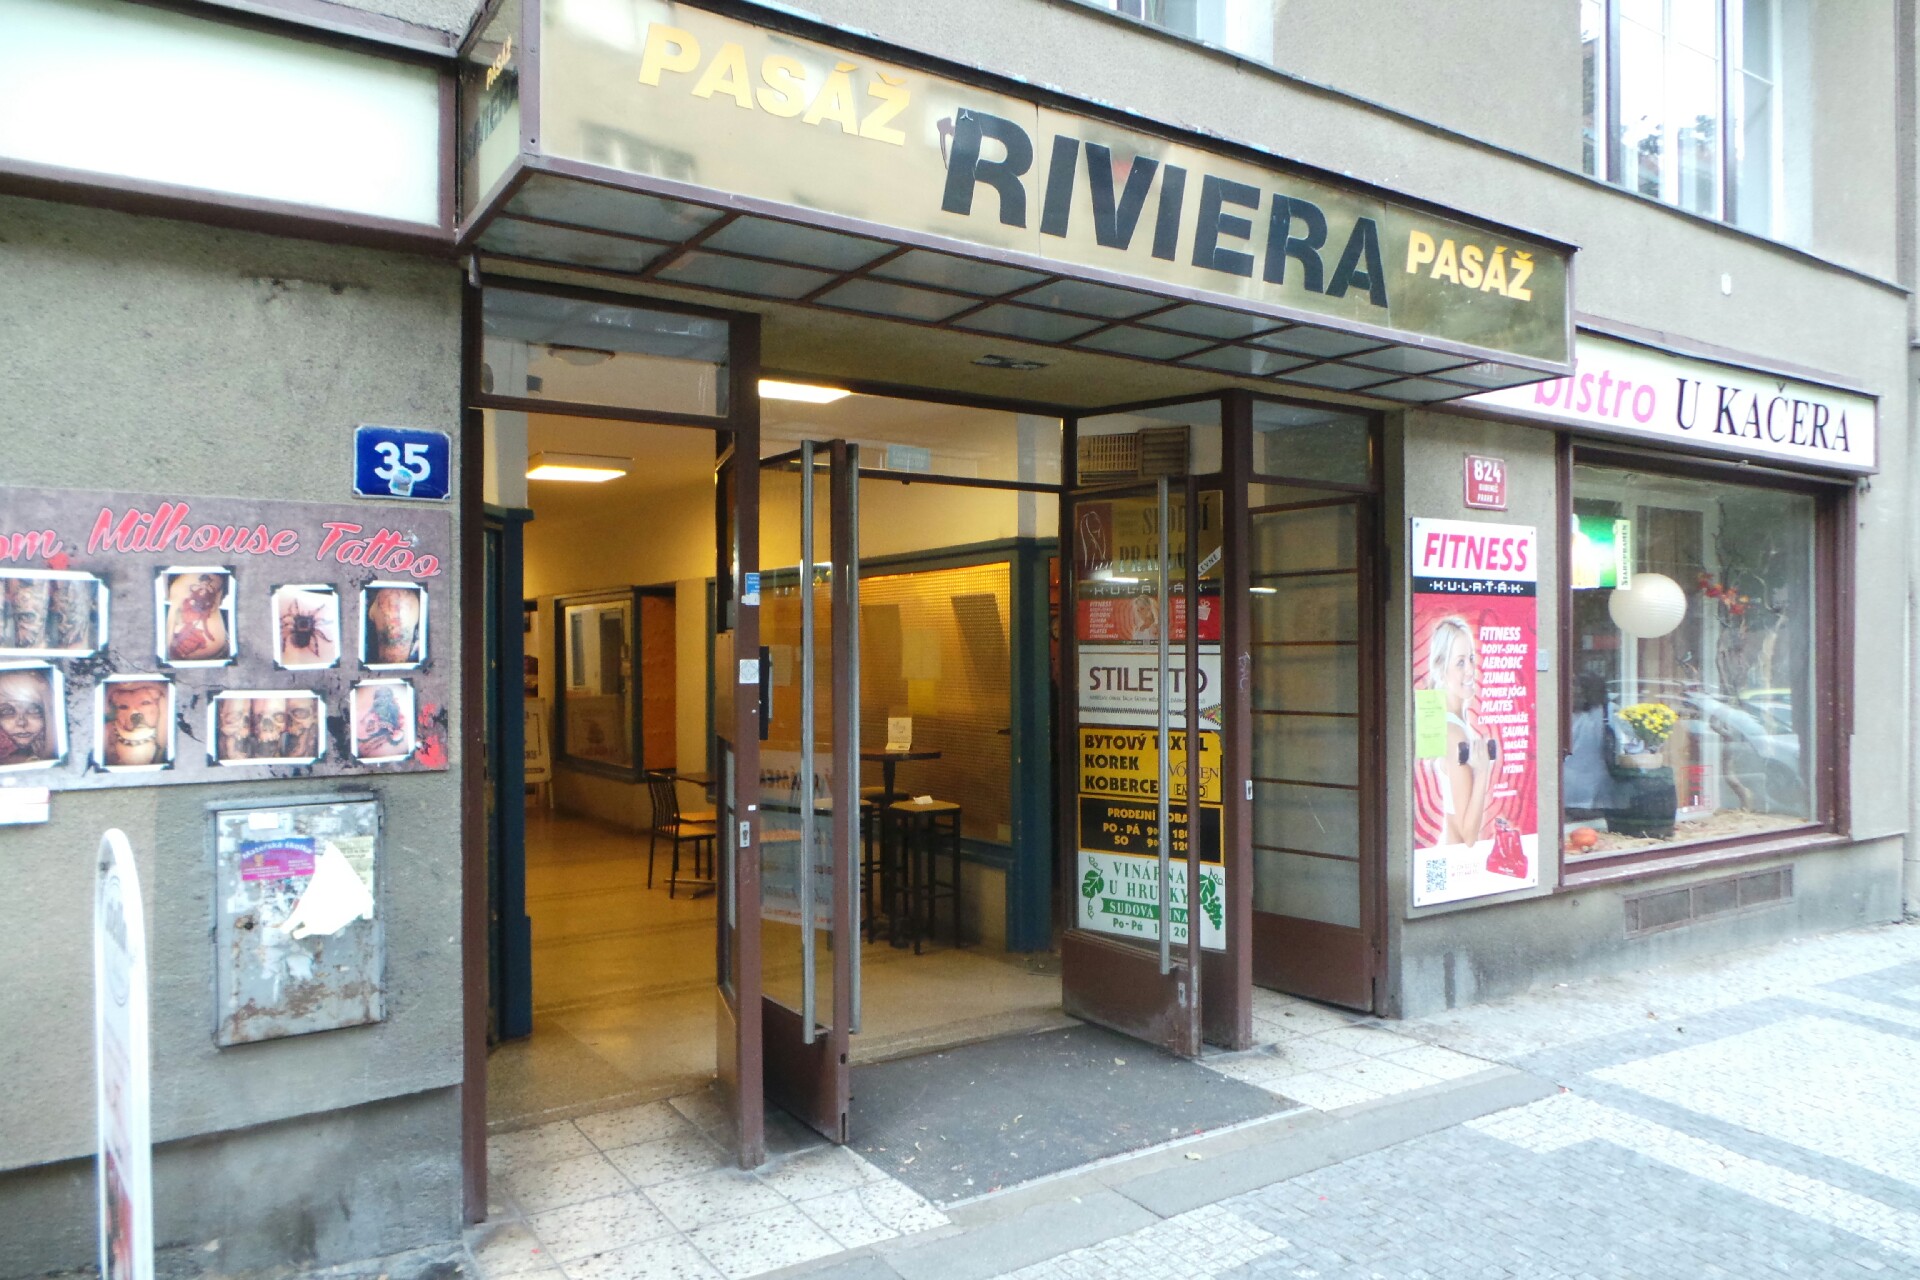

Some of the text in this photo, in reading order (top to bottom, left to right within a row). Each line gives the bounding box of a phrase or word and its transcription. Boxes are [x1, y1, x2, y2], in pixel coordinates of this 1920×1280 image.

[637, 22, 913, 147] PASÁŽ
[941, 106, 1389, 310] RIVIERA
[1405, 229, 1535, 303] PASÁŽ
[1533, 362, 1852, 454] bistro U KAČERA
[373, 441, 431, 482] 35
[1474, 459, 1502, 483] 824
[87, 502, 300, 556] Milhouse
[315, 520, 443, 579] Tattoo
[1423, 532, 1529, 573] FITNESS
[1480, 626, 1521, 641] FITNESS
[1481, 643, 1528, 655] BODY-SPACE
[1482, 656, 1524, 669] AEROBIC
[1089, 666, 1208, 694] STILETO
[1482, 671, 1516, 684] ZUMBA
[1481, 685, 1526, 700] POWER JÓGA
[1481, 700, 1514, 713] PILATES
[1502, 724, 1529, 738] SAUNA
[1084, 733, 1146, 751] BYTOVÝ
[1084, 754, 1140, 771] KOREK
[1084, 775, 1159, 794] KOBERCE
[1107, 807, 1188, 824] PRODEJNÍ OBA
[1103, 822, 1118, 833] PO
[1126, 823, 1141, 836] PÁ
[1114, 834, 1129, 846] SO
[1109, 880, 1189, 904] U HRUKY
[1109, 901, 1154, 918] SUDOVÁ
